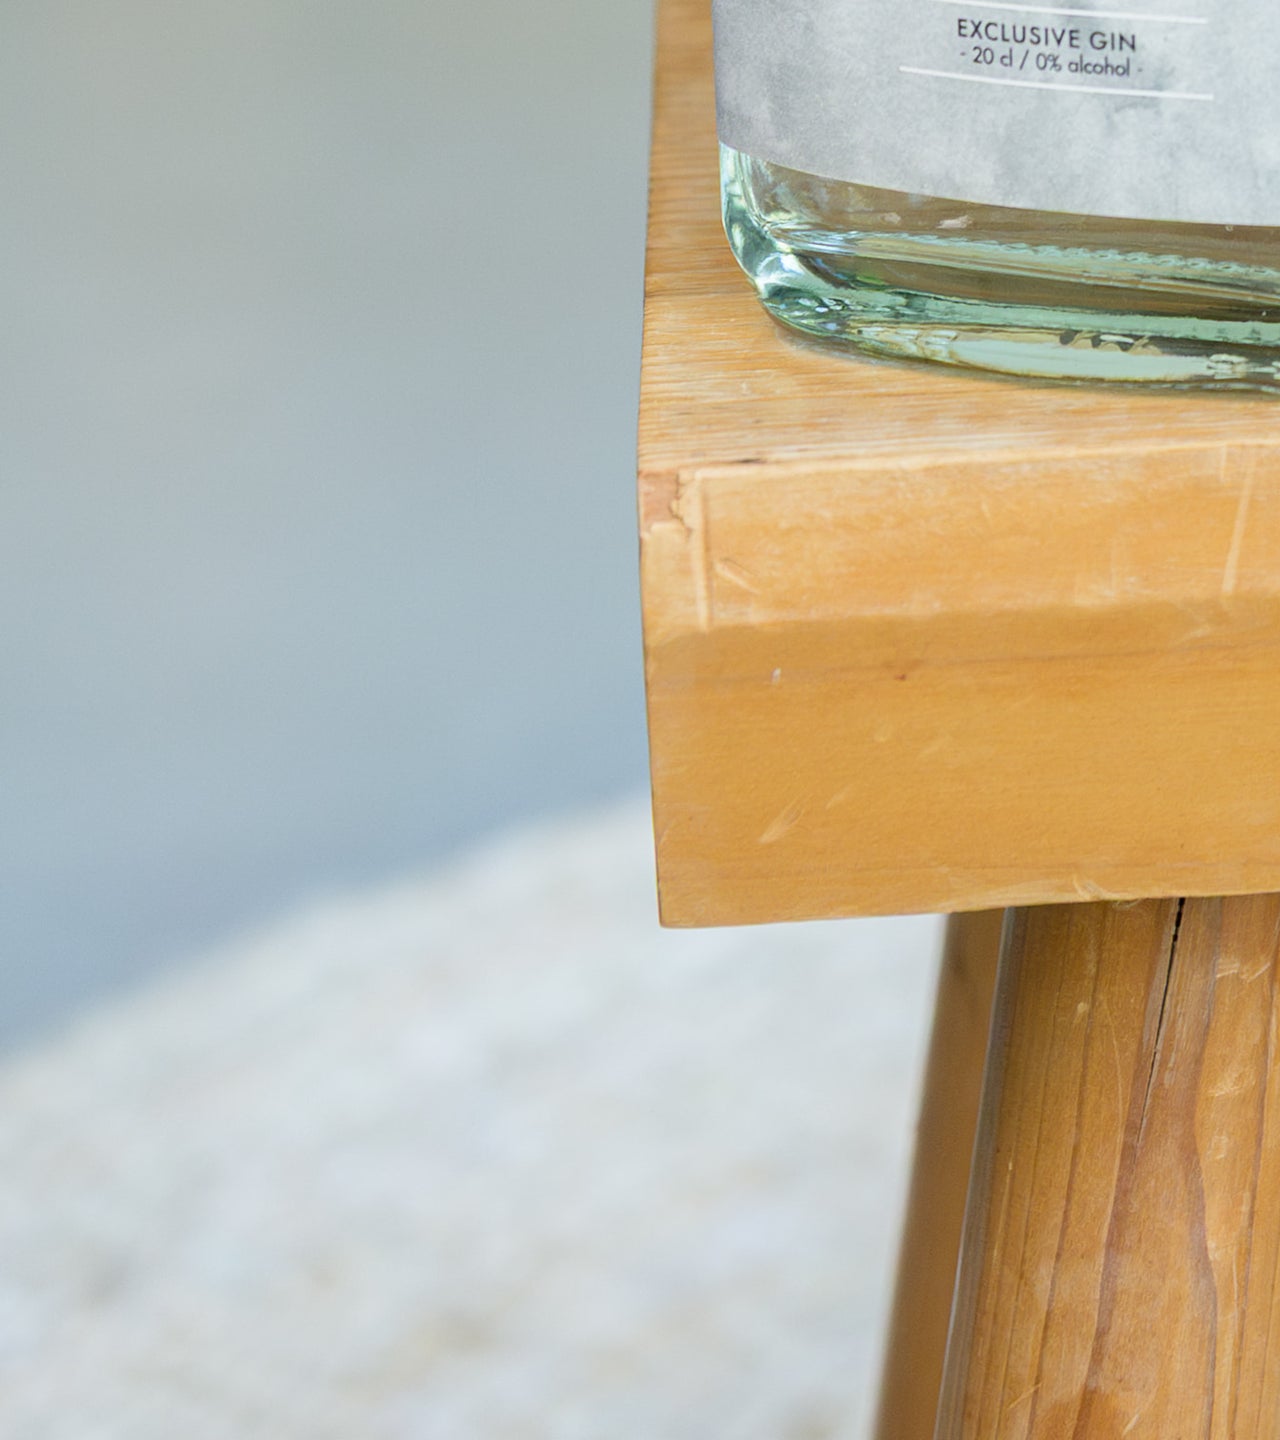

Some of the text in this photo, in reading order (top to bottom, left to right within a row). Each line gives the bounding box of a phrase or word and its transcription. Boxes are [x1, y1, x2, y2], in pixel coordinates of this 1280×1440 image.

[957, 18, 1137, 52] EXCLUSIVE GIN
[972, 46, 994, 65] 20
[1000, 48, 1013, 67] cl
[1035, 52, 1062, 72] 0%
[1068, 54, 1130, 76] alcohol
